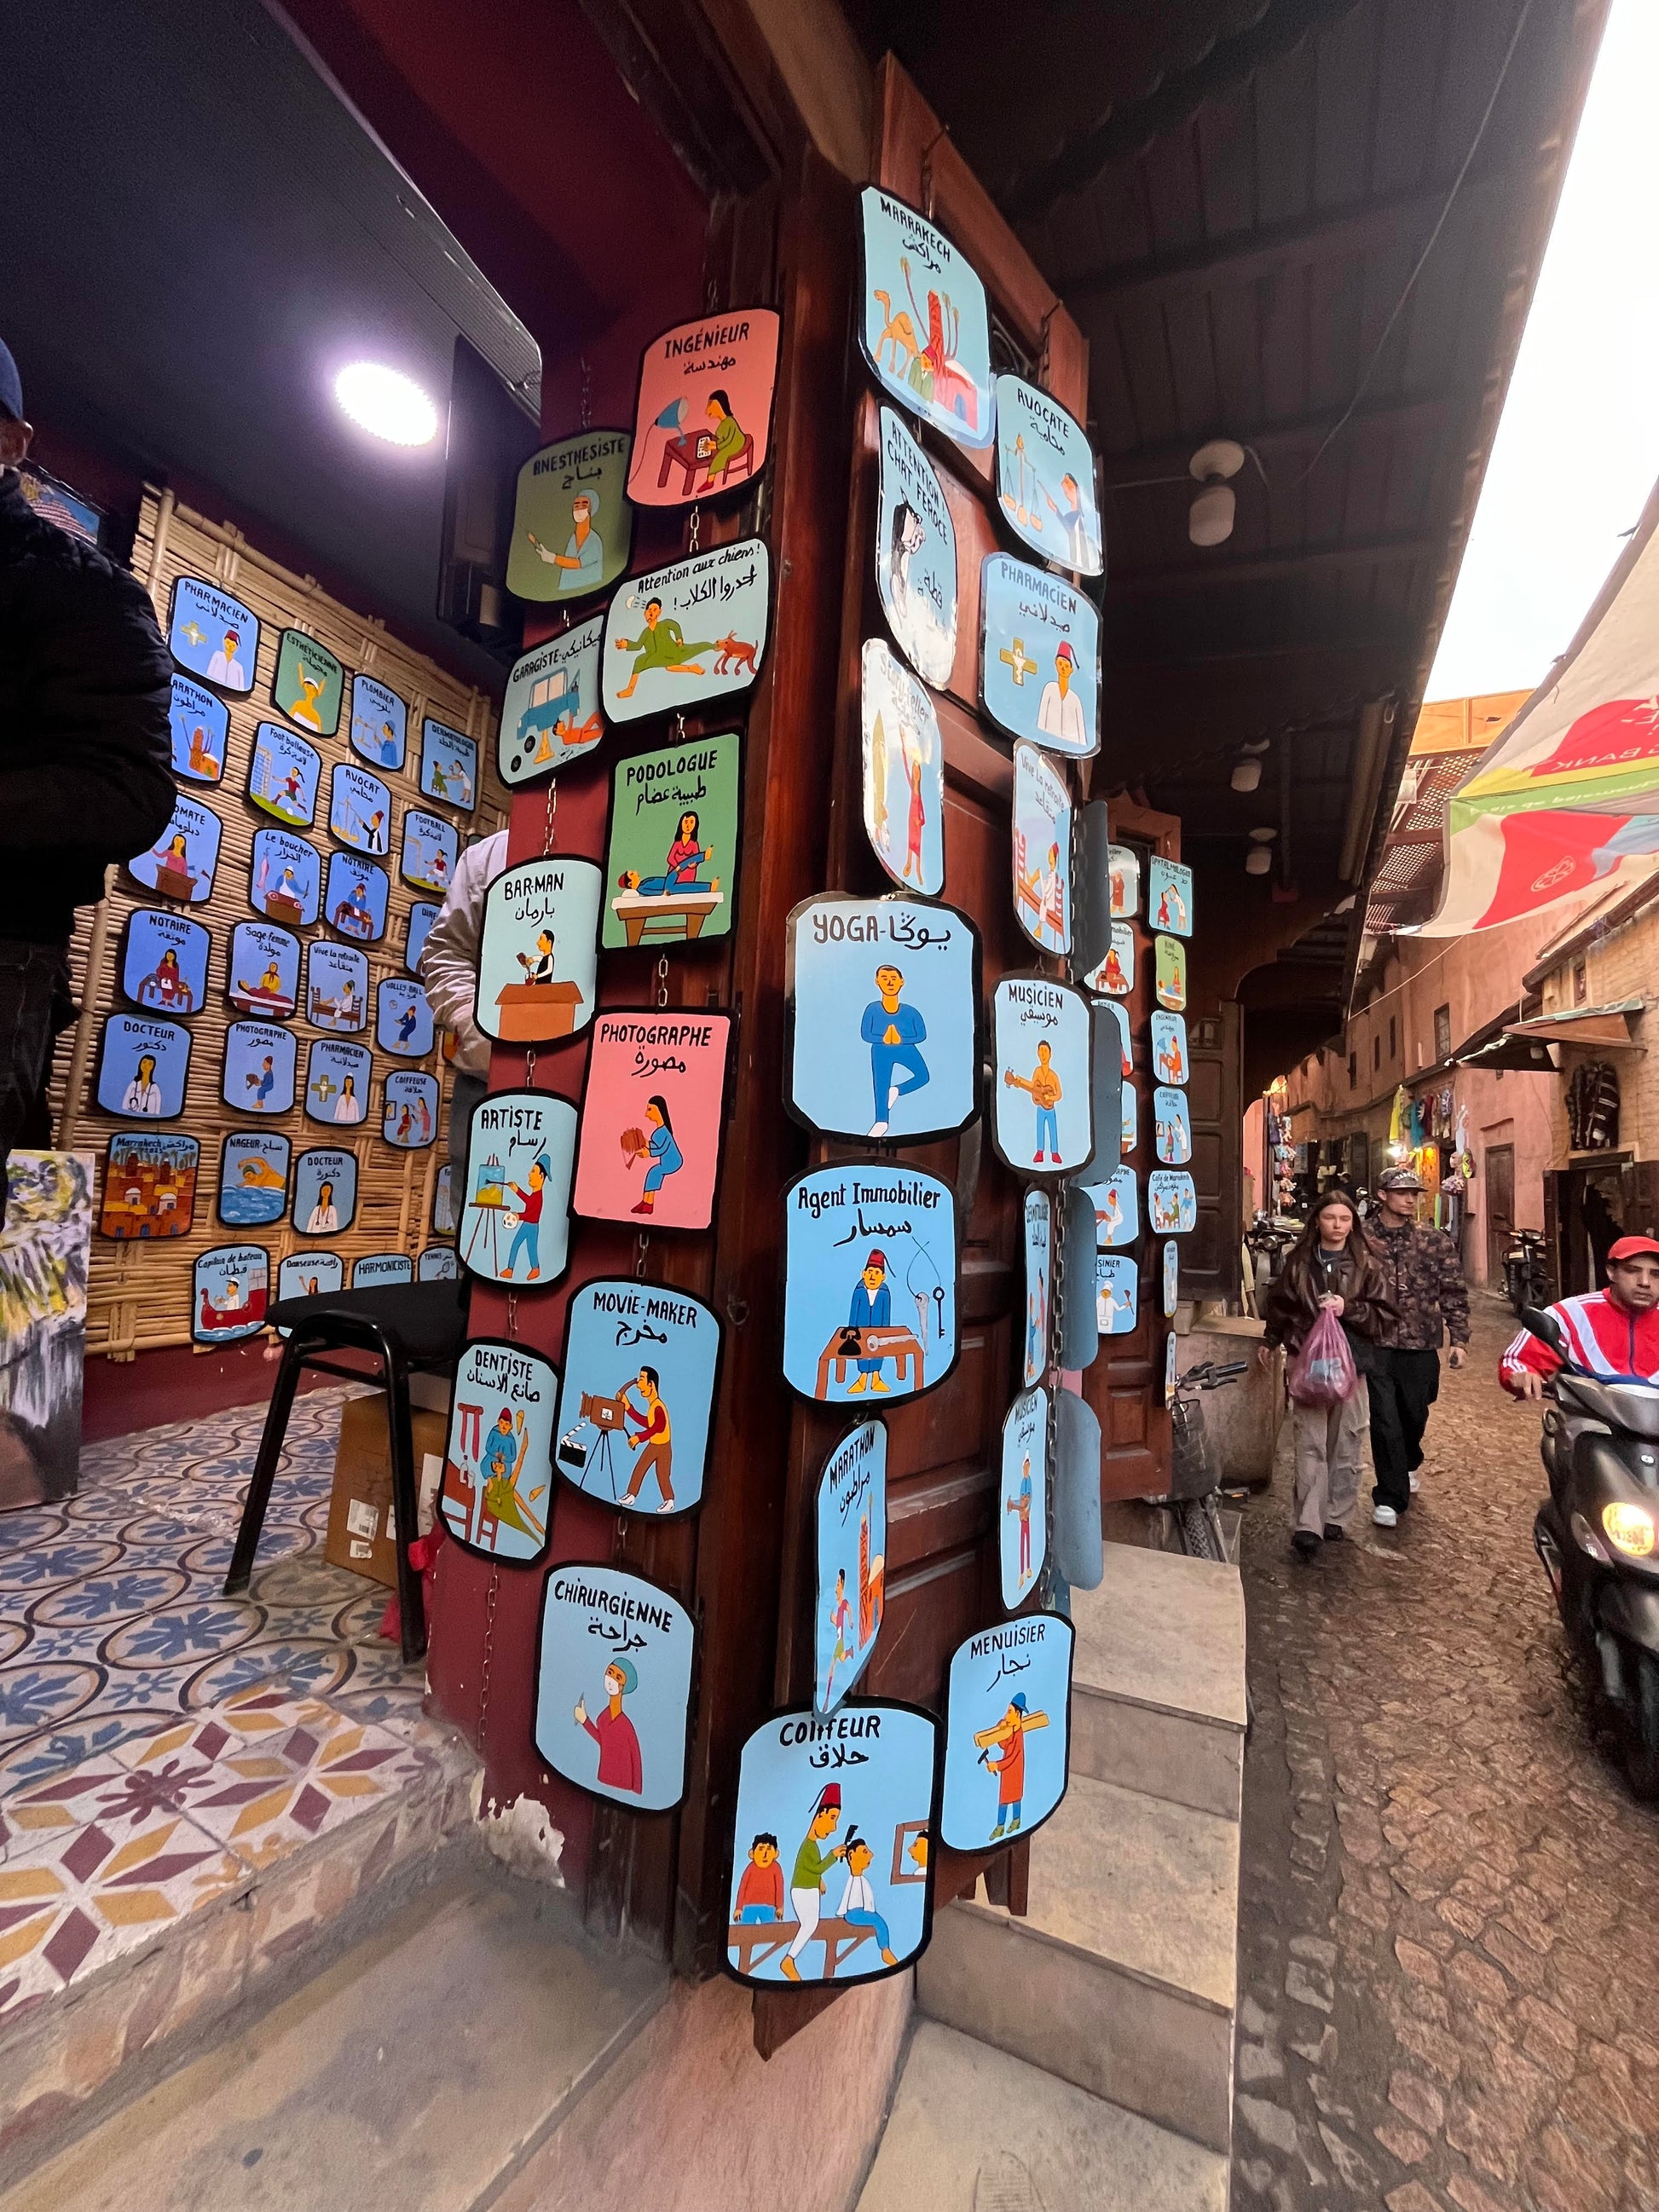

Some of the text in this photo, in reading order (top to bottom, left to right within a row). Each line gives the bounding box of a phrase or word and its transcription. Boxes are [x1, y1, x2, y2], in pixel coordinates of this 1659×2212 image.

[880, 196, 951, 263] MARRAKECH
[1017, 388, 1069, 438] AVOCATE
[533, 437, 625, 476] ANESTHESISTE
[887, 441, 912, 487] CHAT
[638, 566, 689, 593] Attention
[692, 558, 715, 575] aux
[1001, 561, 1077, 615] PHARMACIEN
[184, 581, 248, 623] PHARMACIEN
[171, 679, 213, 708] ARATHON
[361, 679, 395, 707] PLOMBIER
[345, 769, 381, 795] AVOCAT
[627, 749, 718, 786] PODOLOGUE
[174, 806, 206, 825] OMATE
[415, 814, 445, 832] FOOTBALL
[265, 831, 314, 858] Le boucher
[342, 855, 373, 875] NOTAIRE
[505, 872, 564, 901] BAR-MAN
[149, 915, 191, 934] NOTAIRE
[515, 897, 554, 927] بارمان
[1008, 983, 1063, 1009] MUSICIEN
[124, 1020, 175, 1041] DOCTEUR
[235, 1023, 287, 1040] PHOTOGRAPHE
[600, 1023, 713, 1047] PHOTOGRAPHE
[321, 1042, 364, 1059] PHARMACIEN
[395, 1075, 427, 1086] COIFFEUSE
[481, 1105, 543, 1131] ARTISTE
[116, 1138, 161, 1148] Marrakech
[508, 1129, 546, 1159] رسام
[308, 1157, 344, 1166] DOCTEUR
[798, 1180, 941, 1219] Agent Immobilier
[833, 1208, 912, 1247] سمسار
[358, 1260, 411, 1274] HARMONICISTE
[1098, 1257, 1120, 1268] SINIER
[593, 1289, 697, 1328] MOVIE-MAKER
[475, 1349, 533, 1381] DENTISTE
[829, 1426, 875, 1493] MARATHON
[554, 1578, 673, 1633] CHIRURGIENNE
[587, 1616, 647, 1652] جراحة
[970, 1622, 1045, 1660] MENUISIER
[986, 1653, 1032, 1693] نجار
[810, 1743, 869, 1769] حلاق
